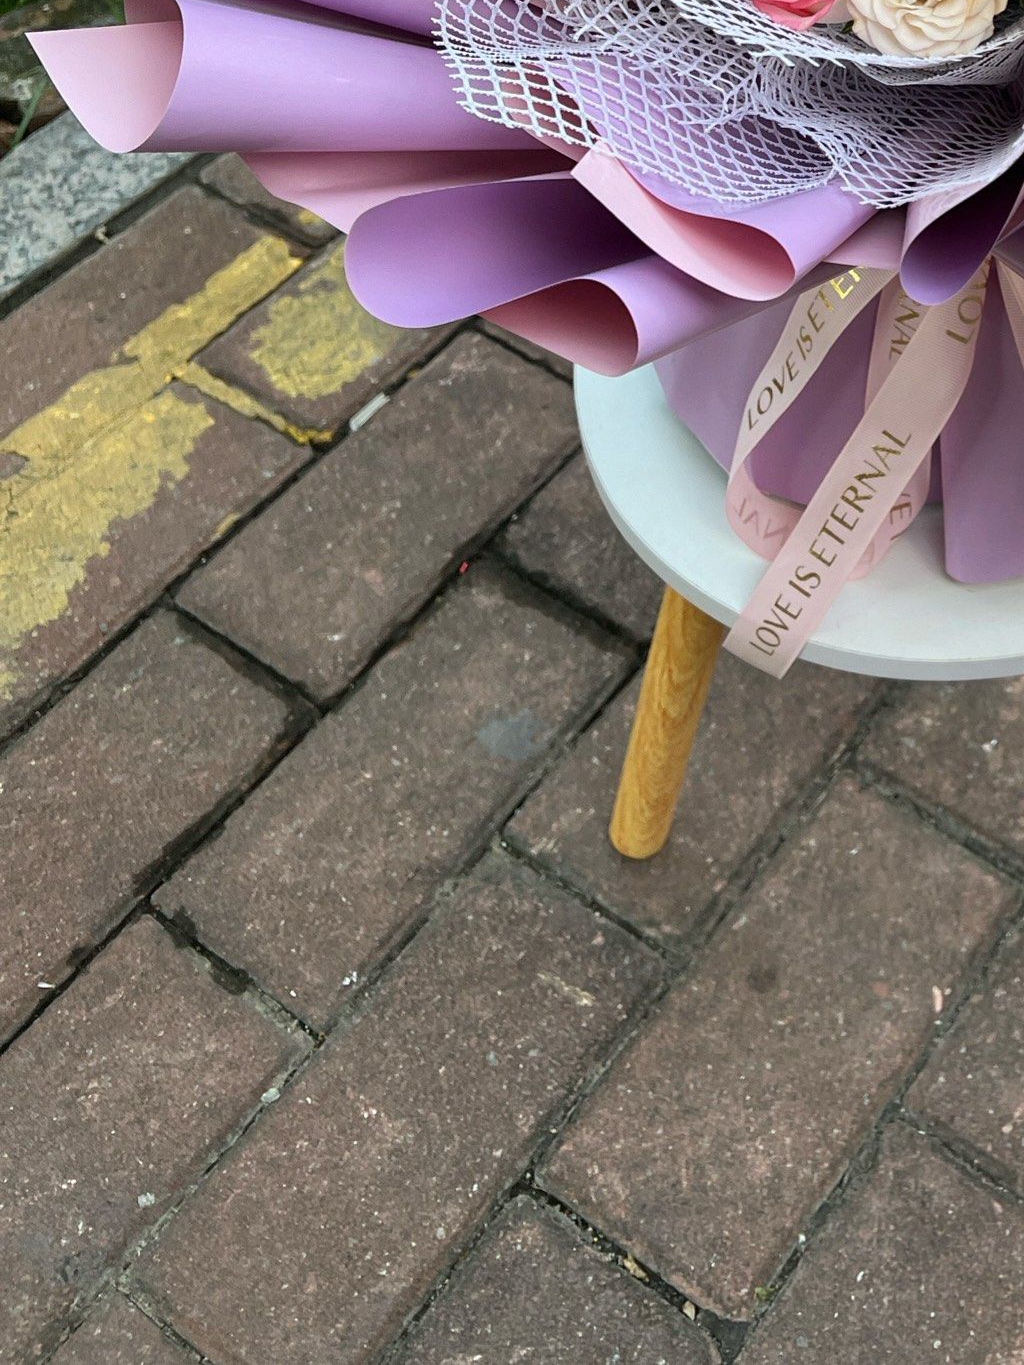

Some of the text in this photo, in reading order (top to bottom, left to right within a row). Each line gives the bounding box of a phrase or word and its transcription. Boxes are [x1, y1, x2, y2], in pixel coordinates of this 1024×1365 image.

[746, 351, 801, 431] LOVE
[797, 324, 814, 362] IS
[748, 592, 804, 657] LOVE
[787, 564, 822, 599] IS
[808, 429, 913, 568] ETERNAL
